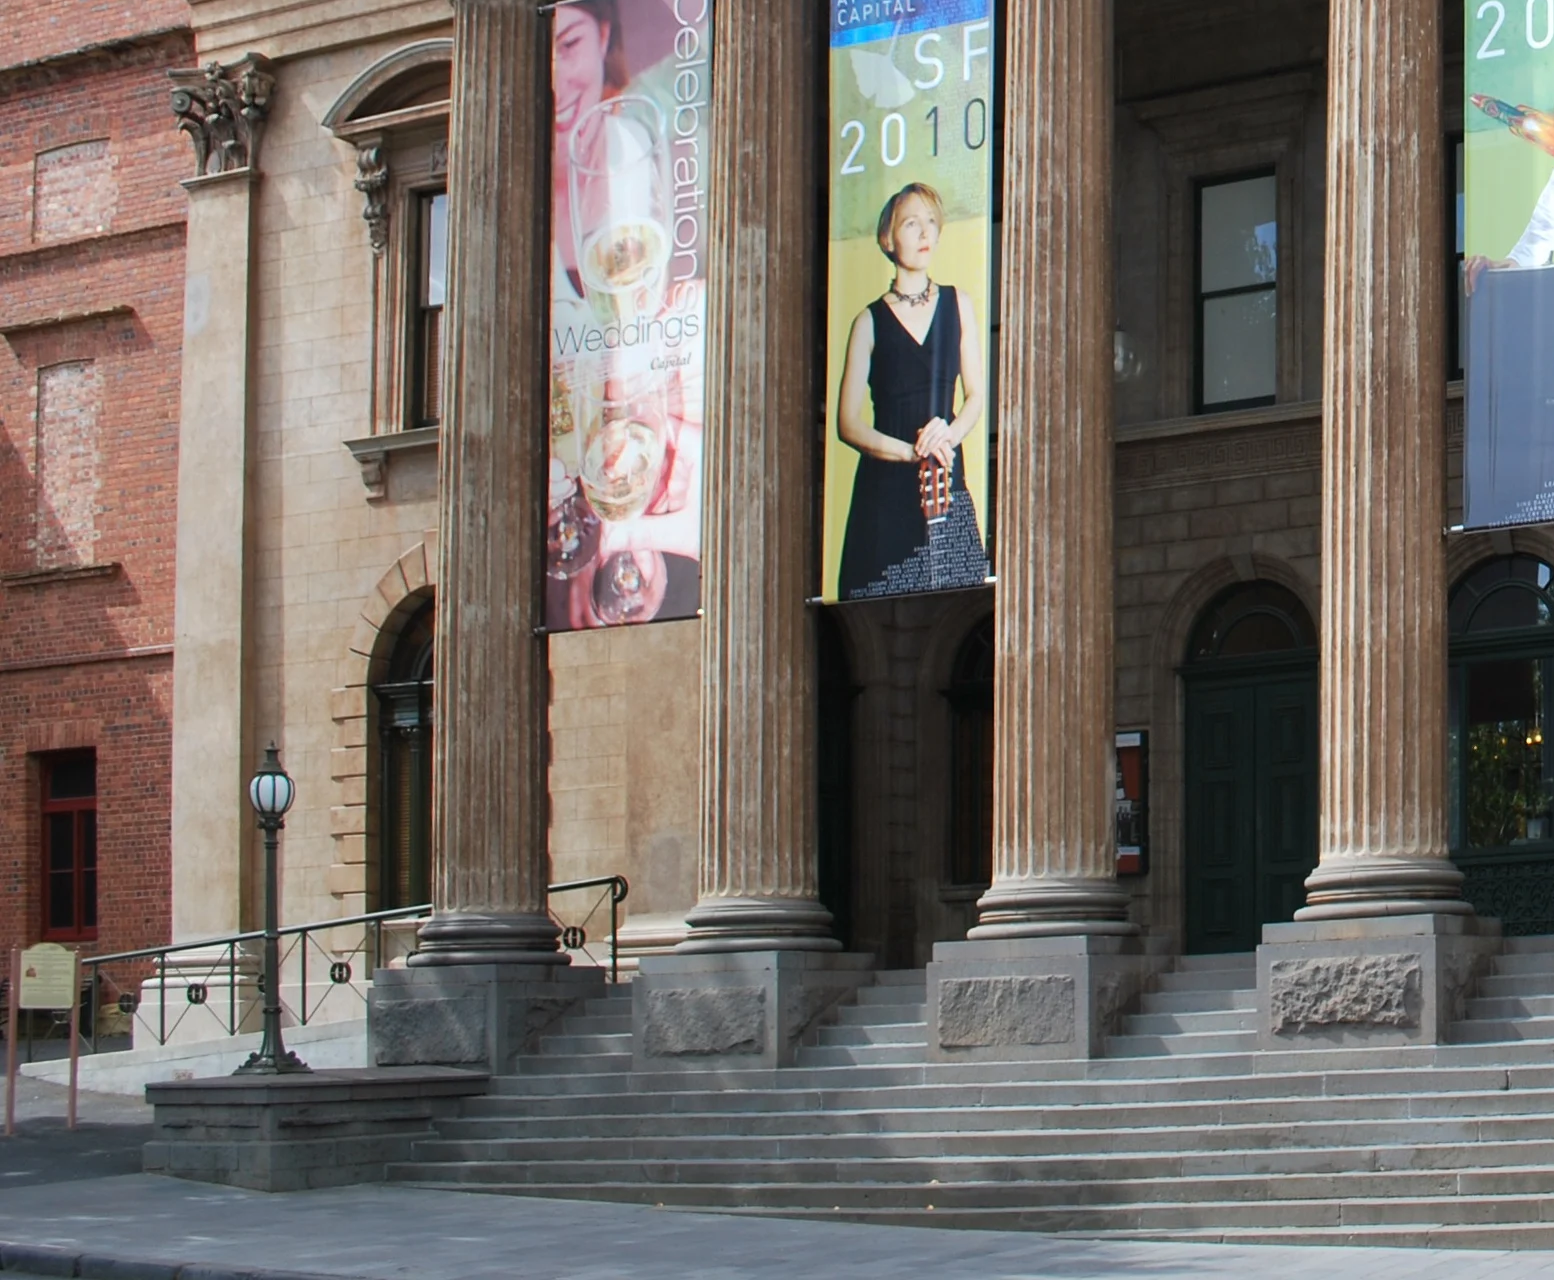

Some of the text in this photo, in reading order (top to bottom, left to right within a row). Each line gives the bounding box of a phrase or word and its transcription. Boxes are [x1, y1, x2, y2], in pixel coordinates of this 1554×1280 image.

[841, 98, 986, 175] 2010
[555, 314, 699, 355] Weddings
[651, 352, 692, 370] Capital
